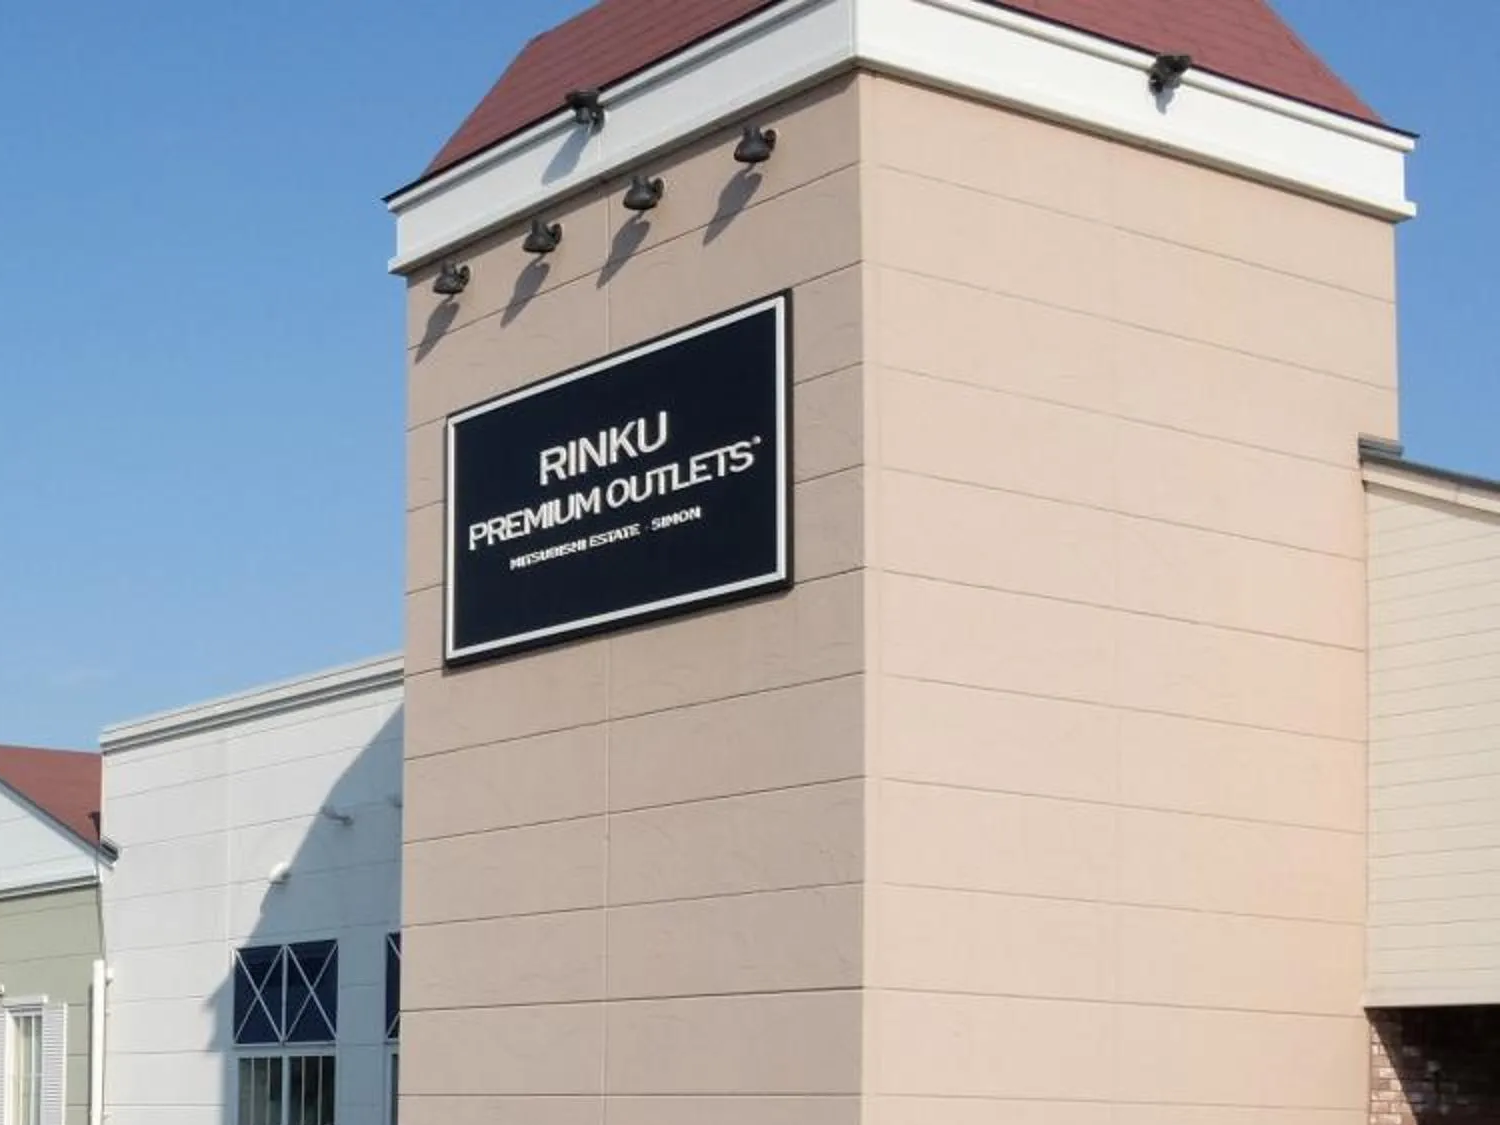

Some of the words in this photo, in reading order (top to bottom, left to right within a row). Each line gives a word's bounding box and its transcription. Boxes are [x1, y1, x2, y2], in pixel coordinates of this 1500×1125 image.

[539, 410, 669, 486] RINKU
[468, 487, 601, 550] PREMIUM
[606, 441, 756, 508] OUTLETS
[510, 539, 587, 571] MITSUBISHI
[589, 523, 641, 548] ESTATE
[651, 506, 701, 531] SIMON
